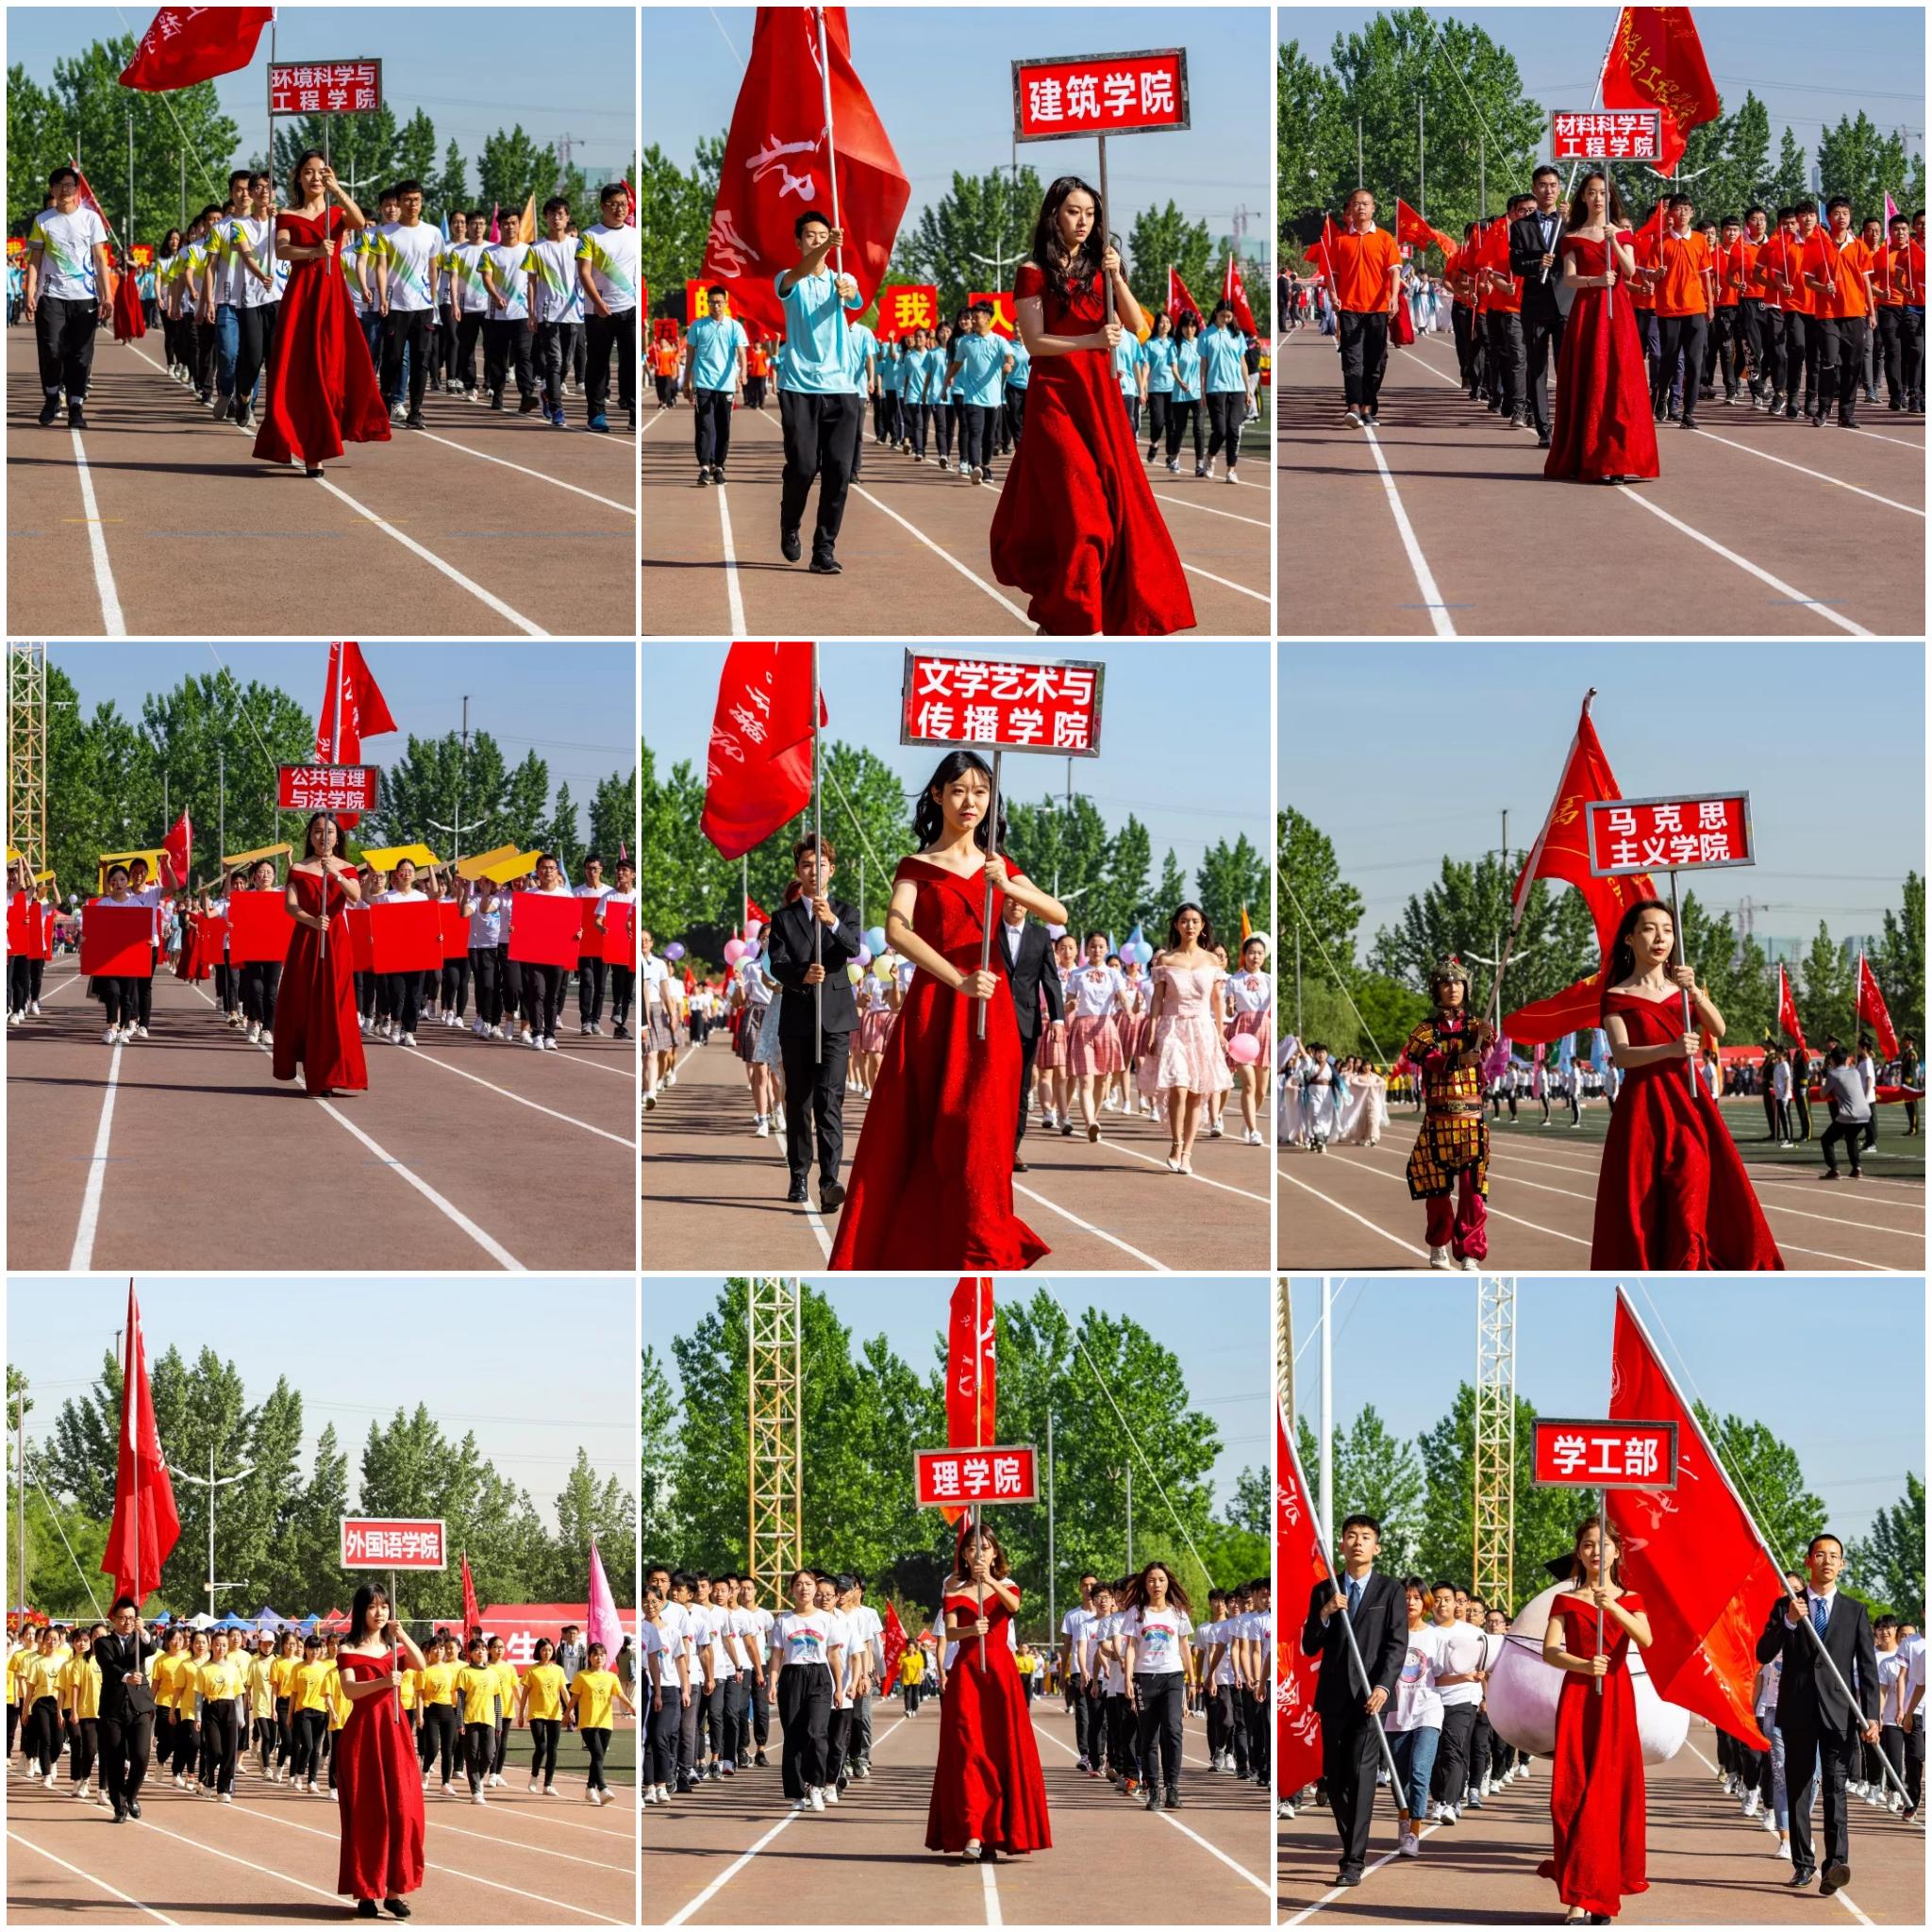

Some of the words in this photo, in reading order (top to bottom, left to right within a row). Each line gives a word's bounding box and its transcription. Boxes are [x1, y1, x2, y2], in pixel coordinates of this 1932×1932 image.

[272, 64, 375, 90] 环境科学与
[272, 88, 375, 112] 工程学院
[1028, 70, 1174, 124] 建筑学院
[1556, 115, 1656, 136] 材料科学与
[1561, 136, 1654, 158] 工程学院
[895, 292, 931, 329] 我
[917, 658, 1094, 706] 文学艺术与
[917, 701, 1089, 749] 传播学院
[291, 767, 366, 788] 公共管理
[290, 791, 365, 809] 与法学院
[1607, 801, 1728, 837] 马克思
[1610, 832, 1730, 869] 主义学院
[1553, 1434, 1658, 1477] 学工部
[932, 1457, 1022, 1496] 理学院
[346, 1529, 440, 1559] 外国语学院
